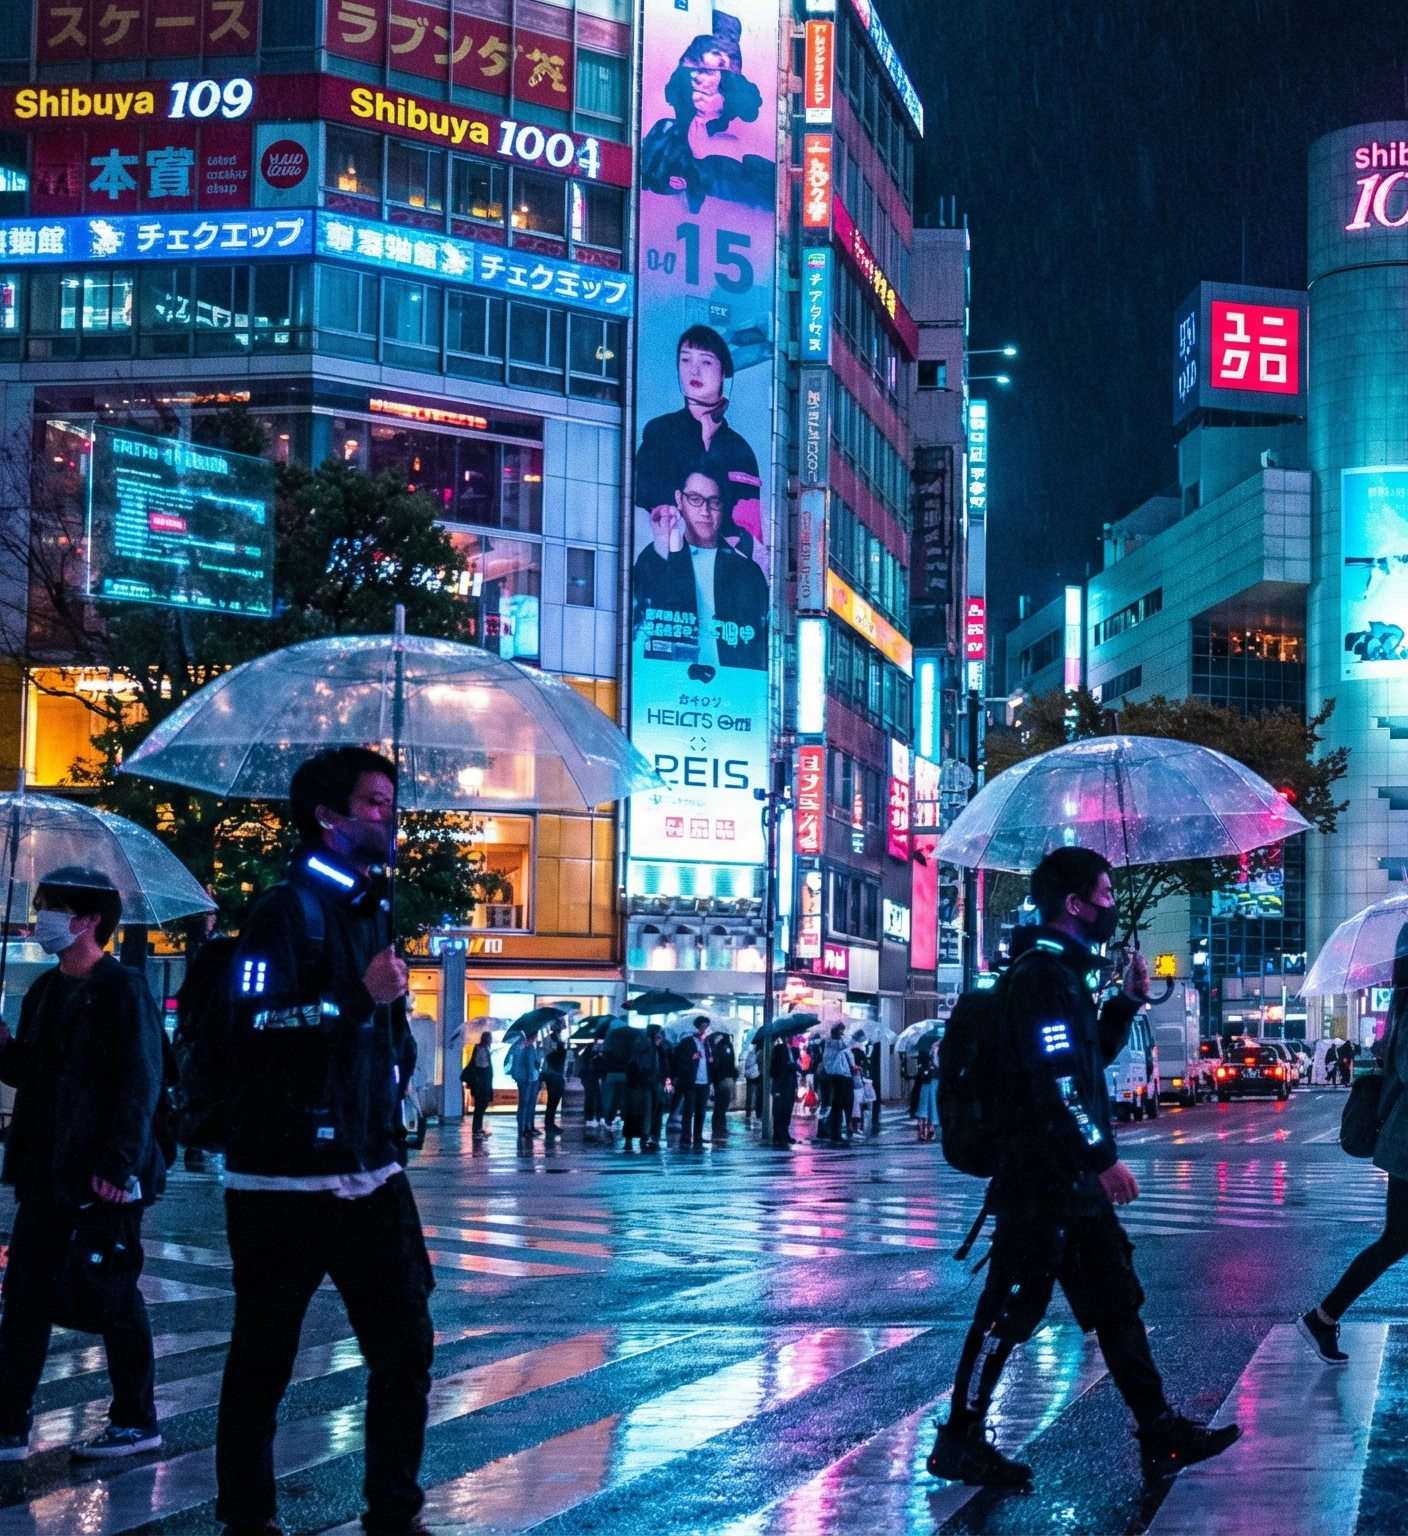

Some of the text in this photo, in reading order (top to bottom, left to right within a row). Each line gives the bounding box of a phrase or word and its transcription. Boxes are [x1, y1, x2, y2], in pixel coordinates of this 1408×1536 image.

[14, 77, 254, 121] Shibuya 109
[350, 87, 489, 146] Shibuya
[676, 221, 754, 295] 15
[1223, 311, 1287, 347] ユニ
[1220, 348, 1287, 384] クロ
